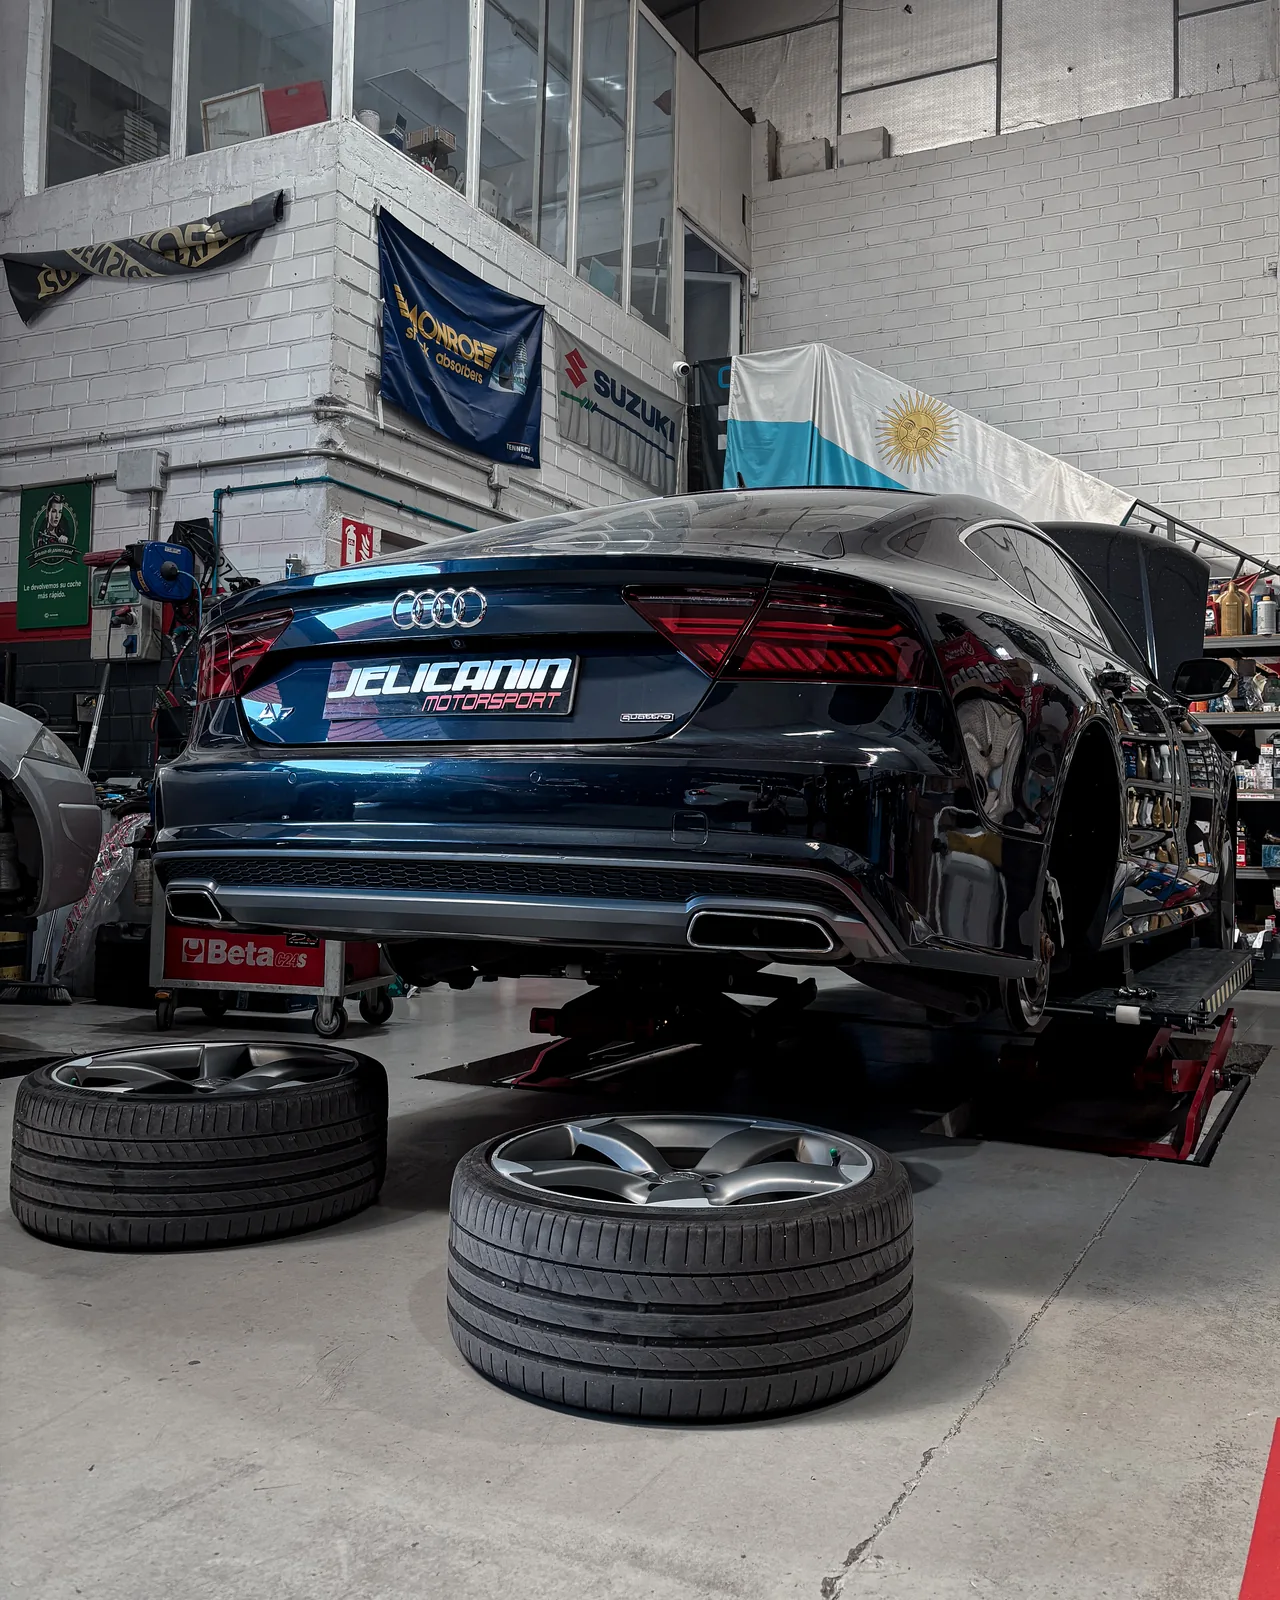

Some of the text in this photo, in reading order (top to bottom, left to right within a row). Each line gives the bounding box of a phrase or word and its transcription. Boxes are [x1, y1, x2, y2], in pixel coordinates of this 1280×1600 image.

[435, 352, 483, 385] absorbers
[593, 369, 676, 444] SUZUKI
[23, 584, 30, 592] Le
[30, 582, 59, 591] devolvemos
[66, 580, 82, 588] coche
[328, 657, 573, 699] JELICANIN
[421, 691, 562, 712] MOTORSPORT
[258, 703, 296, 722] A7
[621, 713, 672, 722] quattro
[207, 938, 274, 967] Beta
[275, 952, 307, 968] C24S
